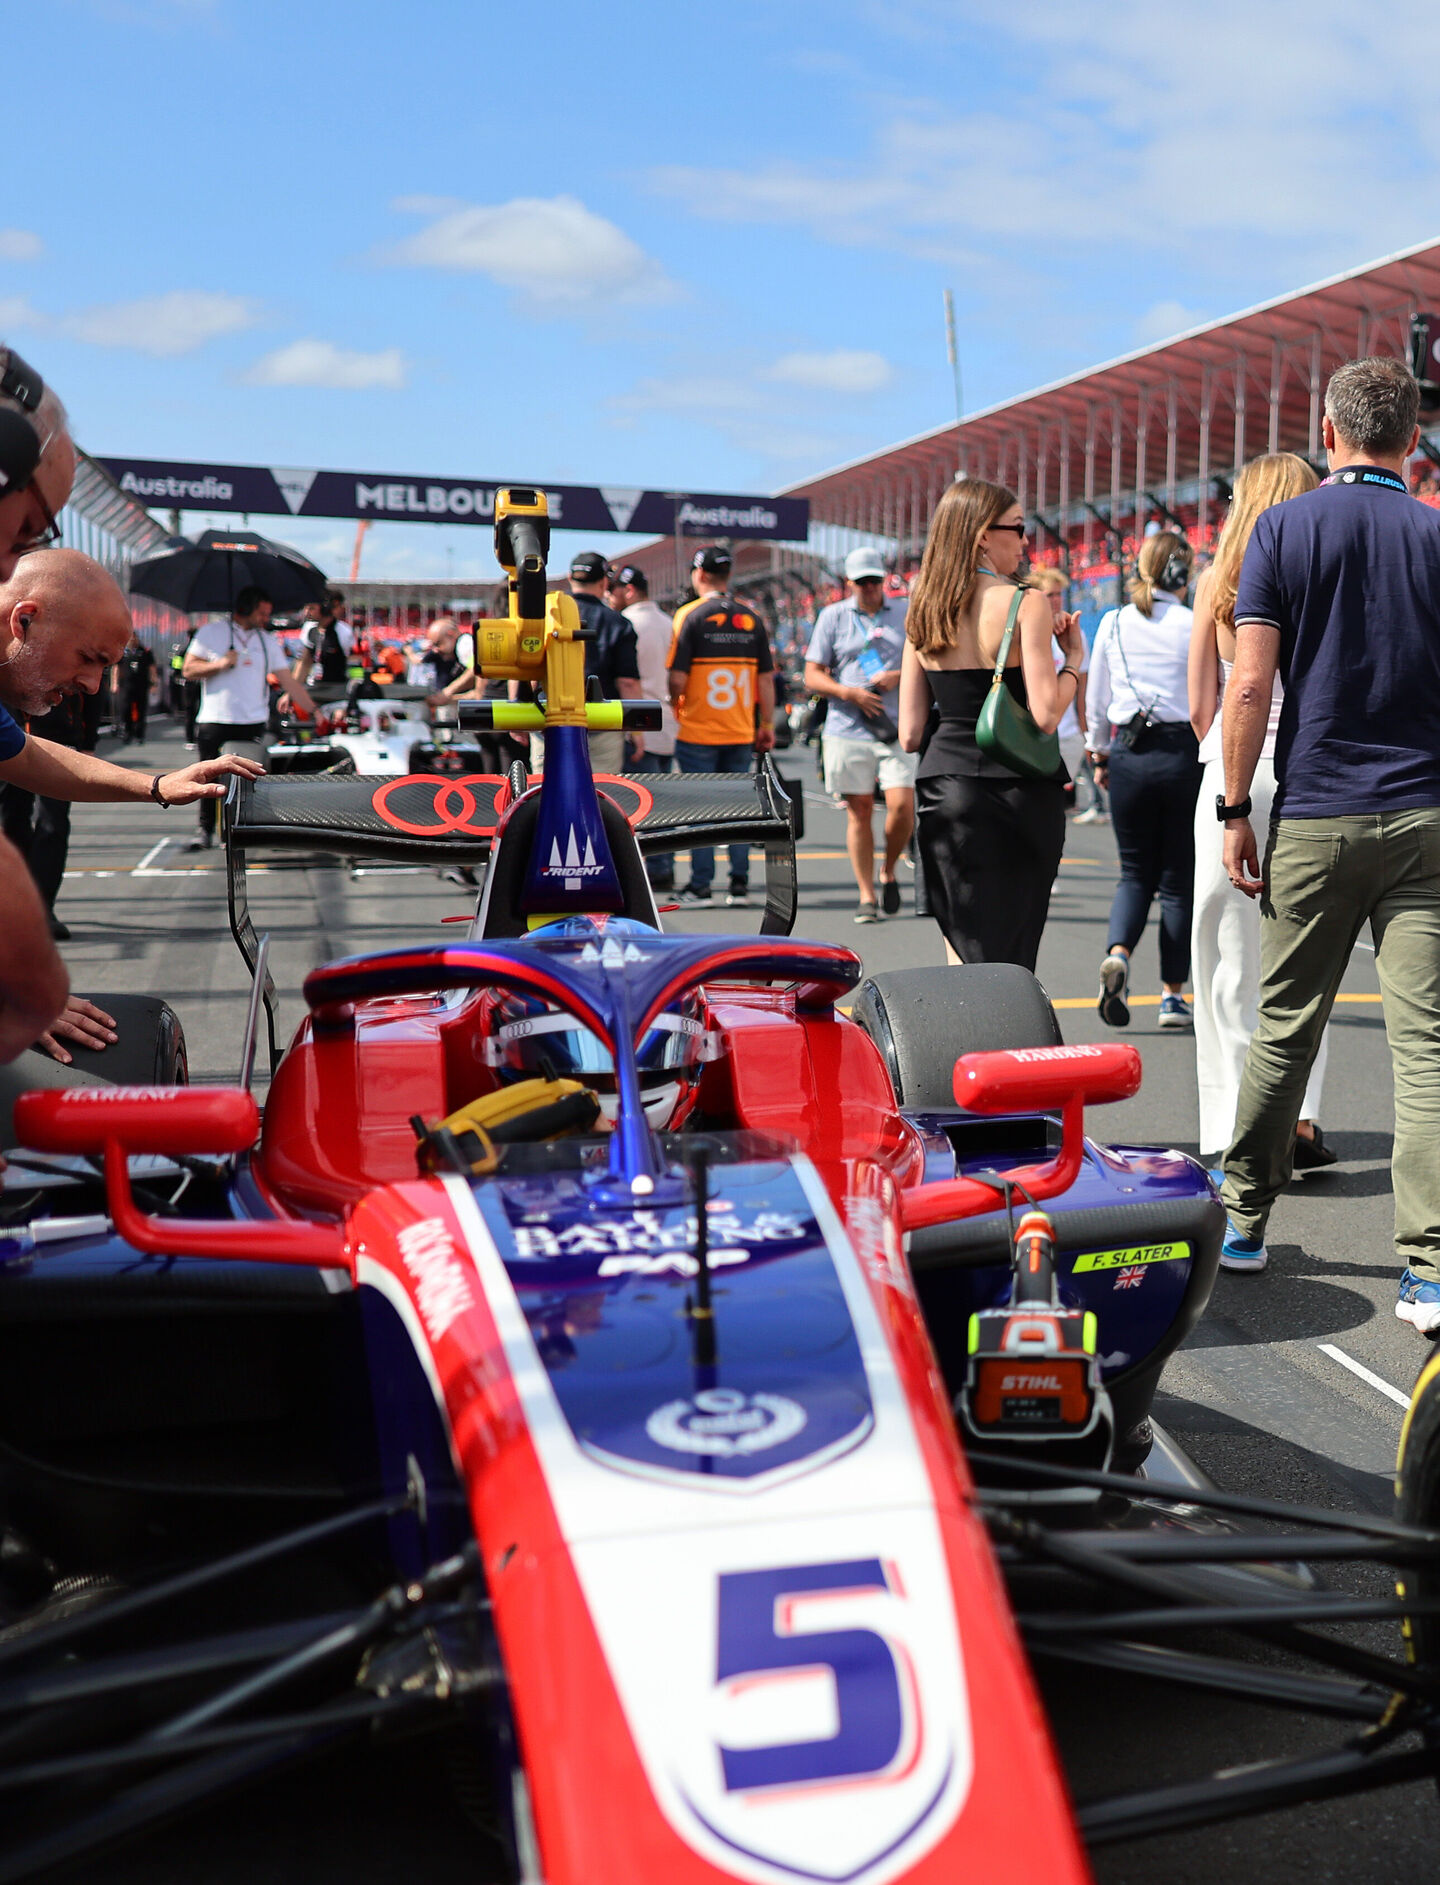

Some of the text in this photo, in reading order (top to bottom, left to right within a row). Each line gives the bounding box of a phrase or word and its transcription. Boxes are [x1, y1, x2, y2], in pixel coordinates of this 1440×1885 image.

[119, 471, 233, 500] Australia
[356, 481, 563, 520] MELBOUE
[679, 502, 778, 529] Australia
[706, 668, 751, 710] 81
[541, 865, 605, 877] TRIDENT
[1092, 1246, 1173, 1268] F. SLATER
[1000, 1375, 1063, 1390] STIHL
[715, 1556, 923, 1805] 5
